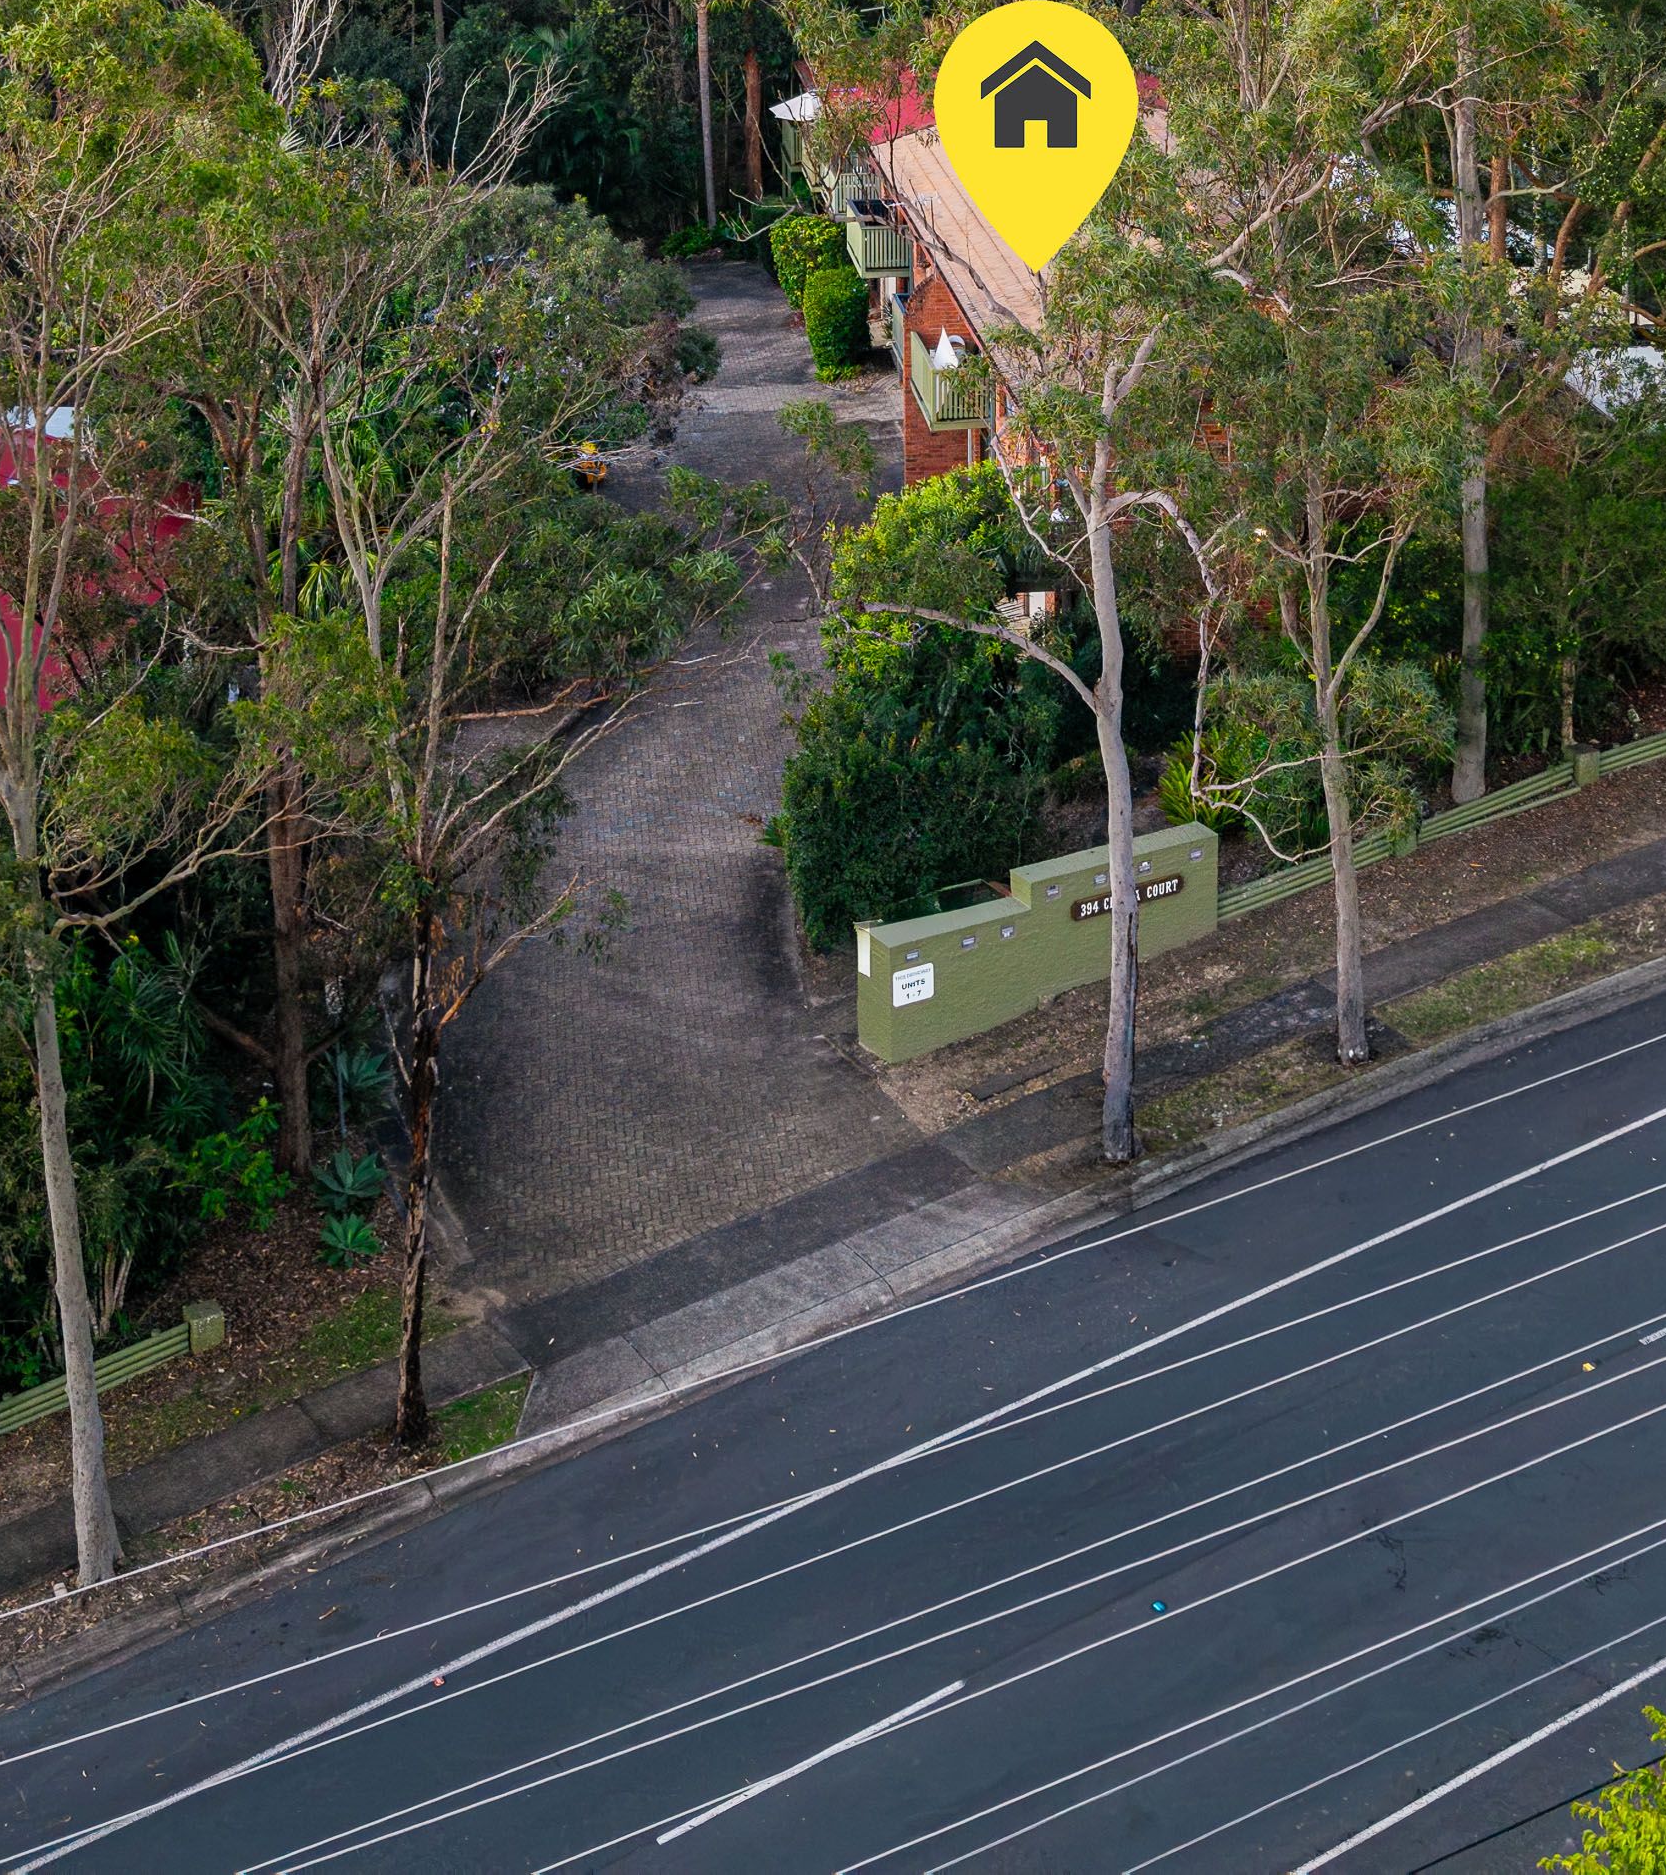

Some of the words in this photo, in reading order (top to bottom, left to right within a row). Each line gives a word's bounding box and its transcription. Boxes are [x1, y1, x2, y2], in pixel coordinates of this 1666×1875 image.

[1080, 900, 1099, 917] 394
[1146, 878, 1179, 899] COURT
[901, 978, 926, 990] UNITS
